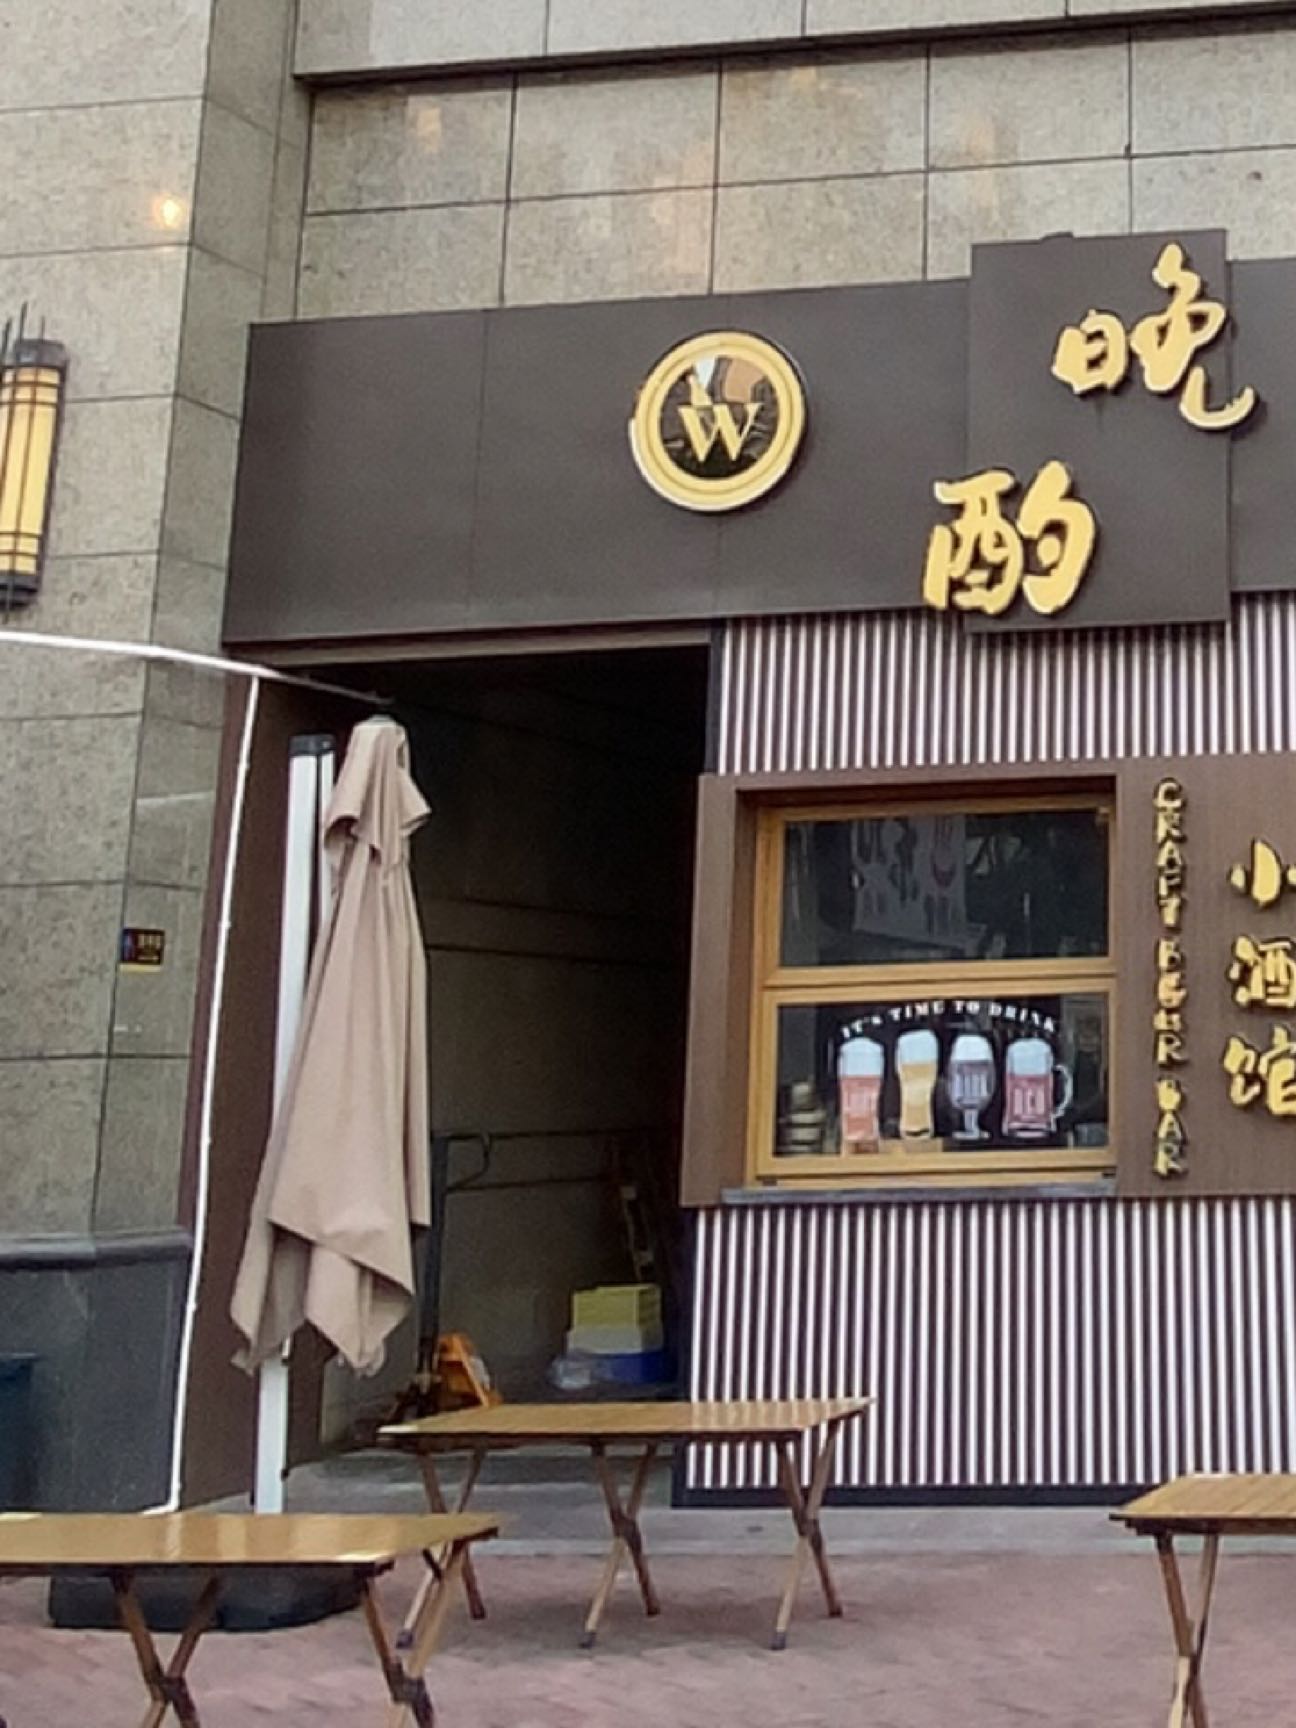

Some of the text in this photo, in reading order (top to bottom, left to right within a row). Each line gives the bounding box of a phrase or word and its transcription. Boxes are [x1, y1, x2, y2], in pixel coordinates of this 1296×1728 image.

[1152, 778, 1186, 928] CRAFT
[888, 999, 945, 1021] TIME
[954, 998, 980, 1015] TO
[987, 1000, 1055, 1034] DRINK
[1154, 1078, 1187, 1177] BAR
